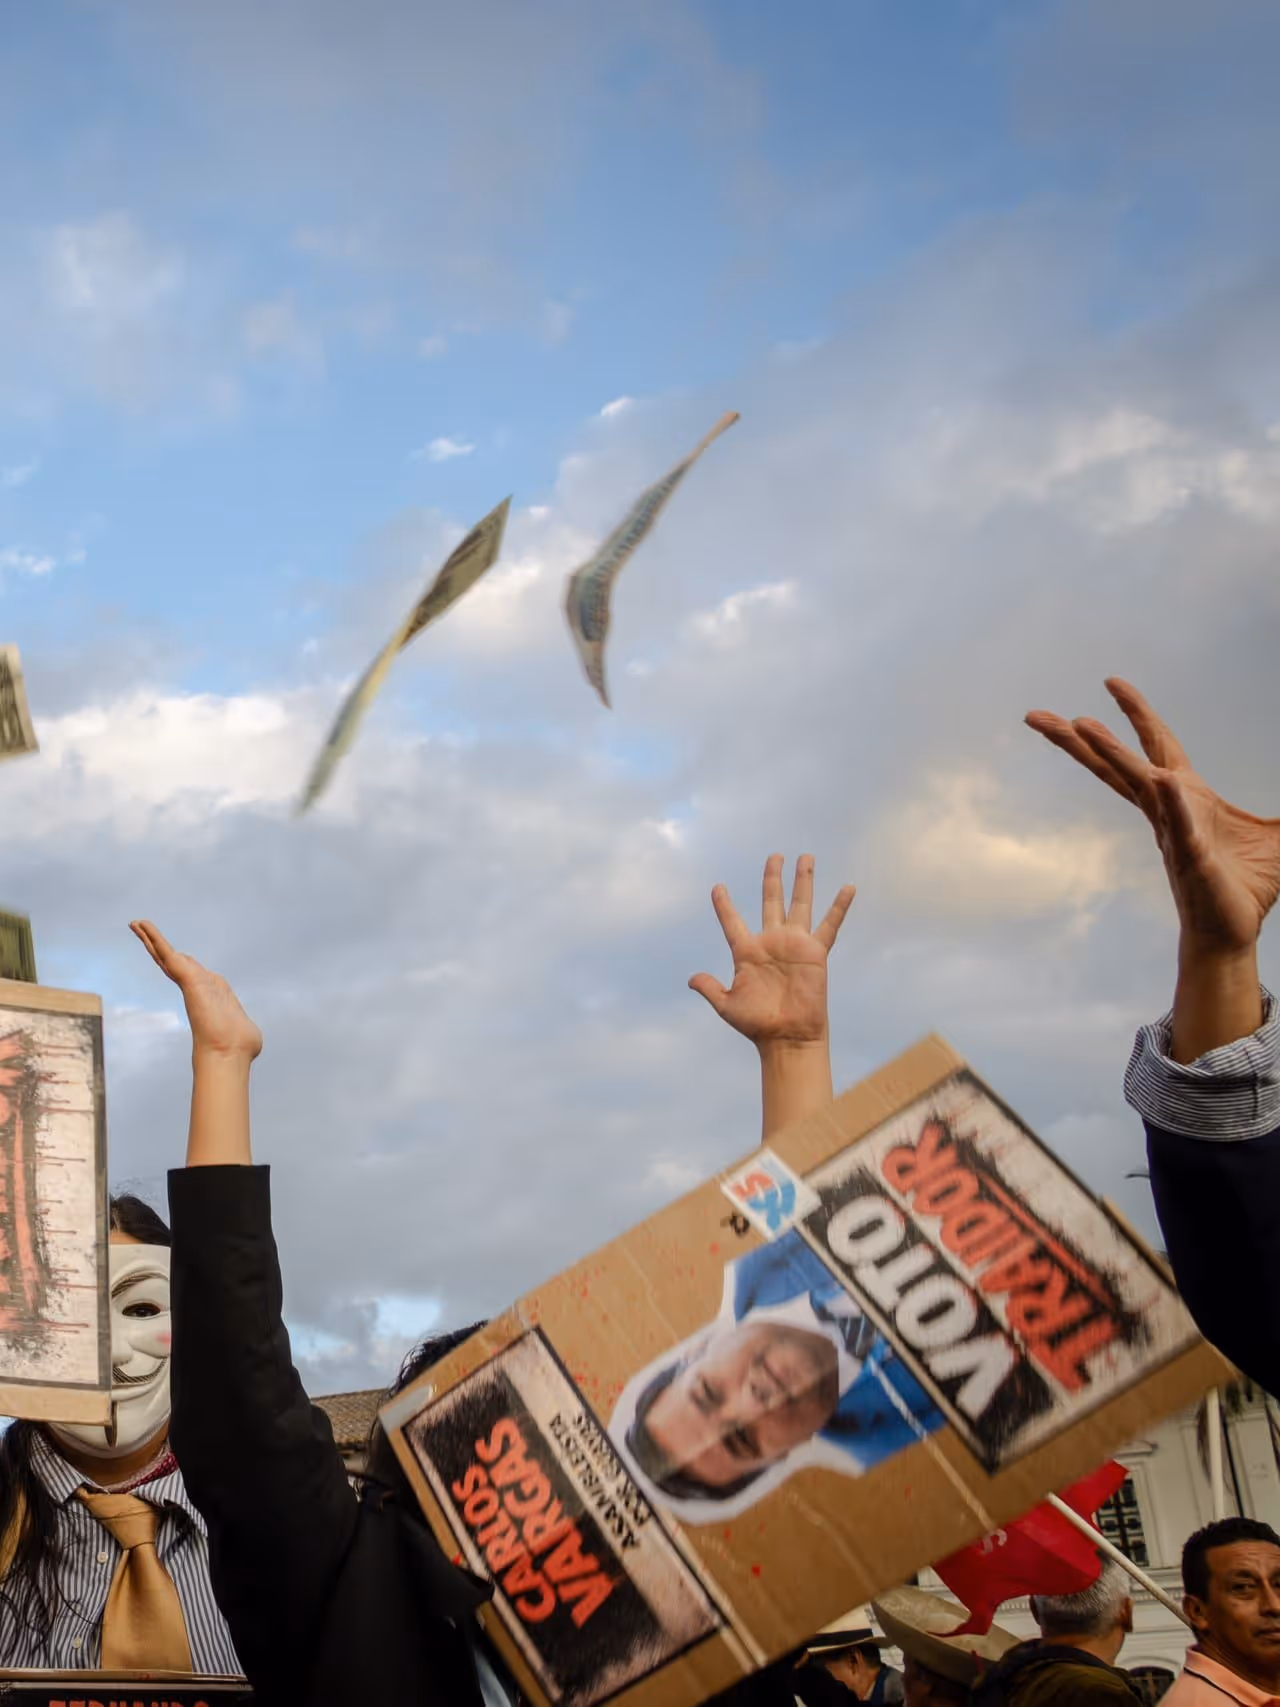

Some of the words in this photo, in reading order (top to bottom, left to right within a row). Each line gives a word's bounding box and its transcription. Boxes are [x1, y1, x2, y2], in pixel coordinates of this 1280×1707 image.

[827, 1195, 1014, 1418] VOTO
[881, 1120, 1118, 1394] TRAIDOR
[451, 1464, 556, 1622] CARLOS
[475, 1417, 613, 1629] VARGAS
